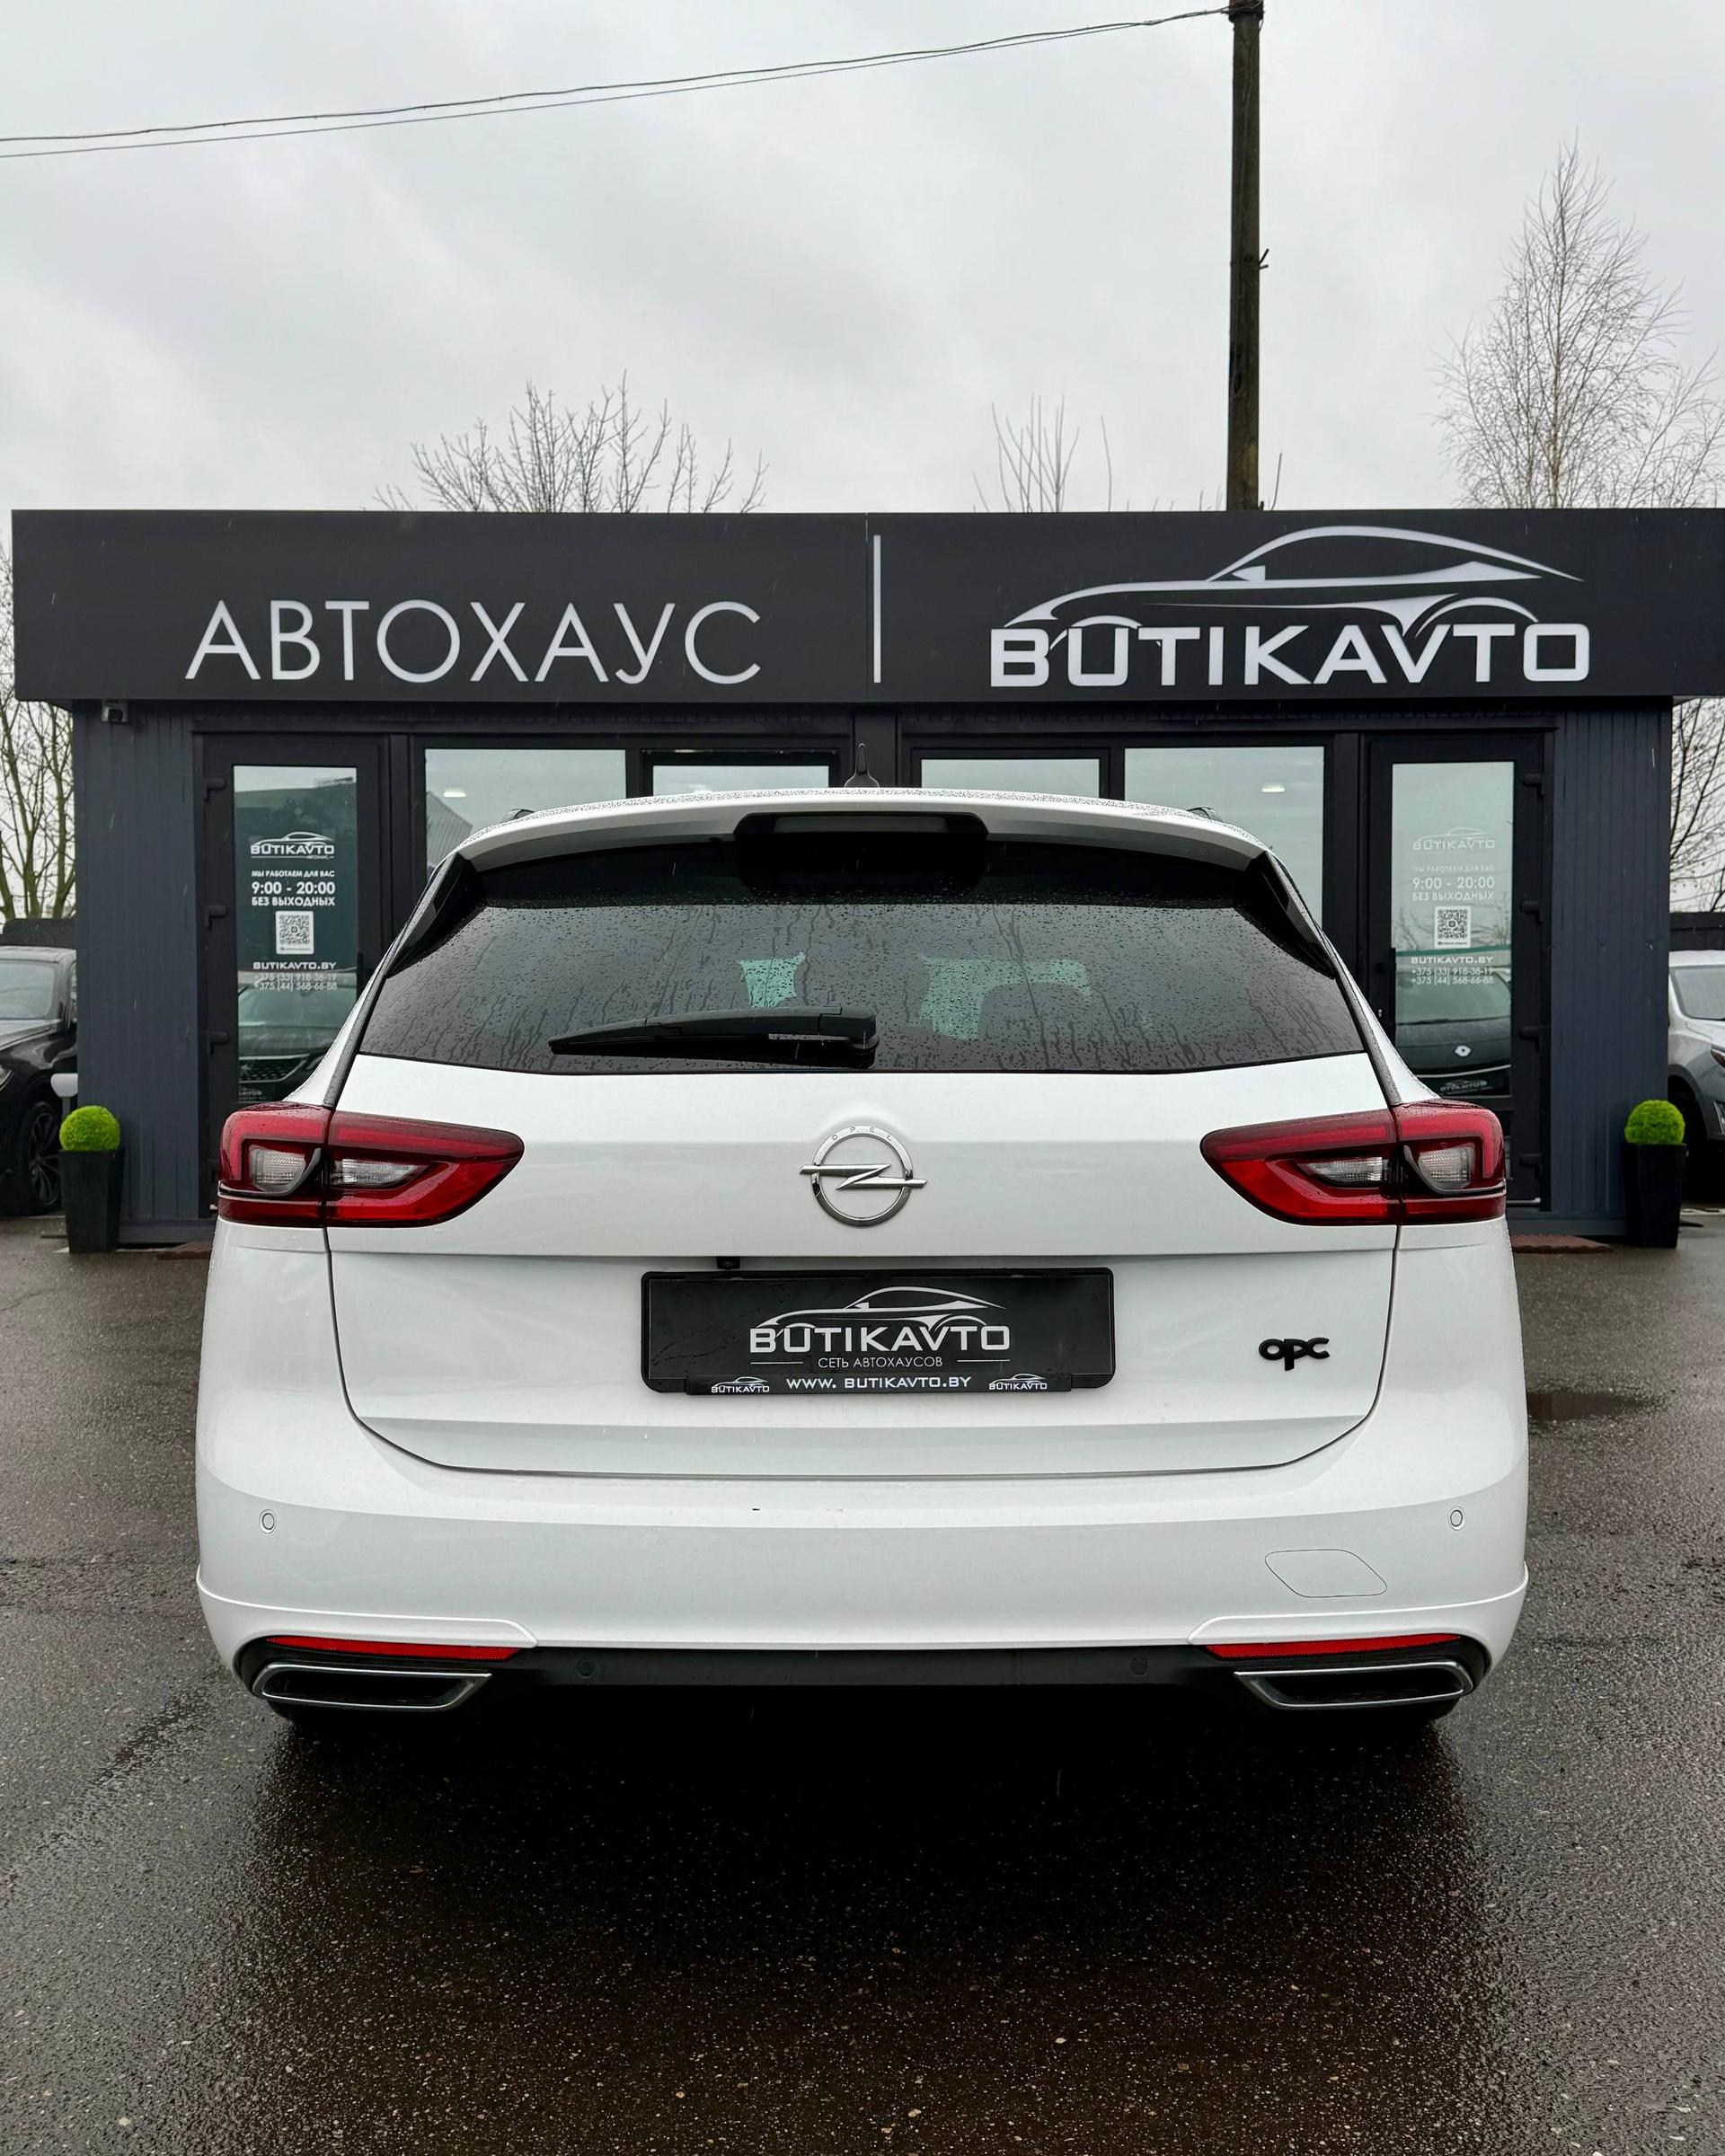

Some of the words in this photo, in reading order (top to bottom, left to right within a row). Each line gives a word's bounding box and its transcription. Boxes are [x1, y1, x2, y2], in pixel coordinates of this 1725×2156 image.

[185, 599, 761, 685] АВТОХАУС
[990, 623, 1589, 687] BUTIKAVTO
[251, 844, 335, 854] BUTIKAVTO
[1412, 840, 1495, 850] BUTIKAVTO
[252, 881, 282, 894] 9:00
[296, 881, 336, 894] 20:00
[1412, 877, 1442, 889] 9:00
[1456, 877, 1495, 888] 20:00
[1412, 892, 1429, 901] БЕЗ
[1432, 891, 1494, 901] ВЫХОДНЫХ
[252, 897, 270, 906] БЕЗ
[271, 897, 335, 906] ВЫХОДНЫХ
[252, 961, 337, 969] BUTIKAVTO.BY
[1411, 956, 1494, 964] BUTIKAVTO.BY
[1411, 968, 1431, 976] +375
[1434, 968, 1450, 976] (33)
[1452, 967, 1493, 976] 918-38-19
[277, 973, 294, 982] (33)
[1411, 976, 1432, 985] +375
[1434, 976, 1450, 985] (44)
[277, 982, 294, 991] (44)
[832, 1127, 892, 1141] OPEL
[749, 1326, 1010, 1353] BUTIKAVTO
[818, 1357, 849, 1368] СЕТЬ
[853, 1356, 943, 1367] АВТОХАУСОВ
[844, 1376, 972, 1389] BUTIKAVTO.BY
[988, 1382, 1048, 1390] BUTIKAVTO
[711, 1385, 770, 1393] BUTIKAVTO
